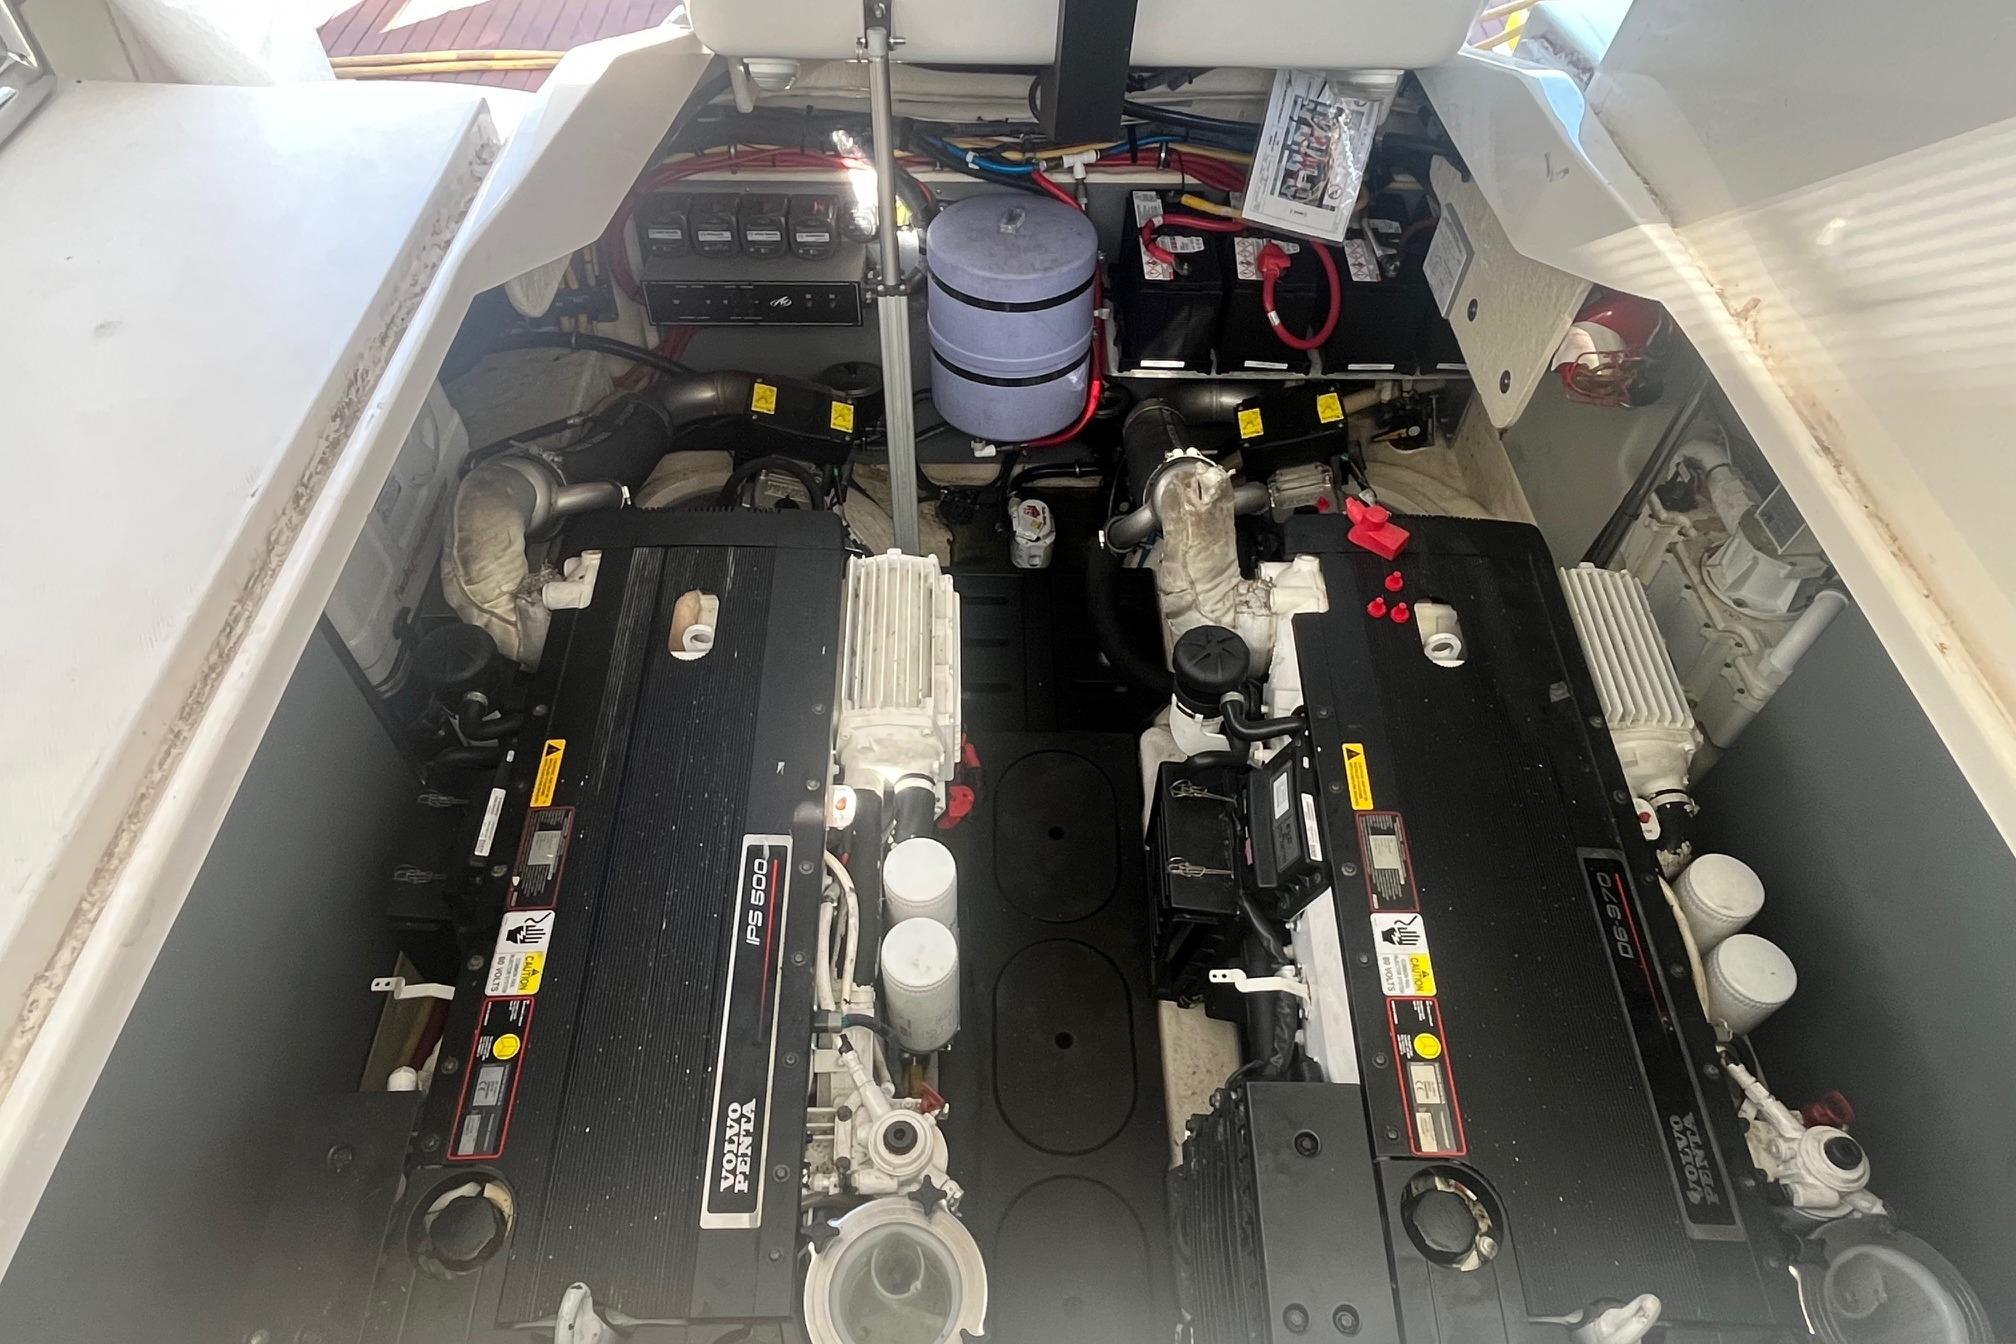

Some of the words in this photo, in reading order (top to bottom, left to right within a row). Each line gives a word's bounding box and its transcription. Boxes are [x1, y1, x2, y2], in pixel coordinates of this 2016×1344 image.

[750, 858, 768, 906] 500
[746, 909, 763, 945] IPS
[491, 967, 503, 992] VOLTS
[518, 955, 535, 991] CAUTION
[1385, 967, 1396, 992] VOLTS
[1410, 957, 1425, 992] CAUTION
[720, 1102, 741, 1192] VOLVO
[734, 1098, 756, 1193] PENTA
[1669, 1114, 1704, 1205] VOLVO
[1682, 1111, 1720, 1205] PENTA
